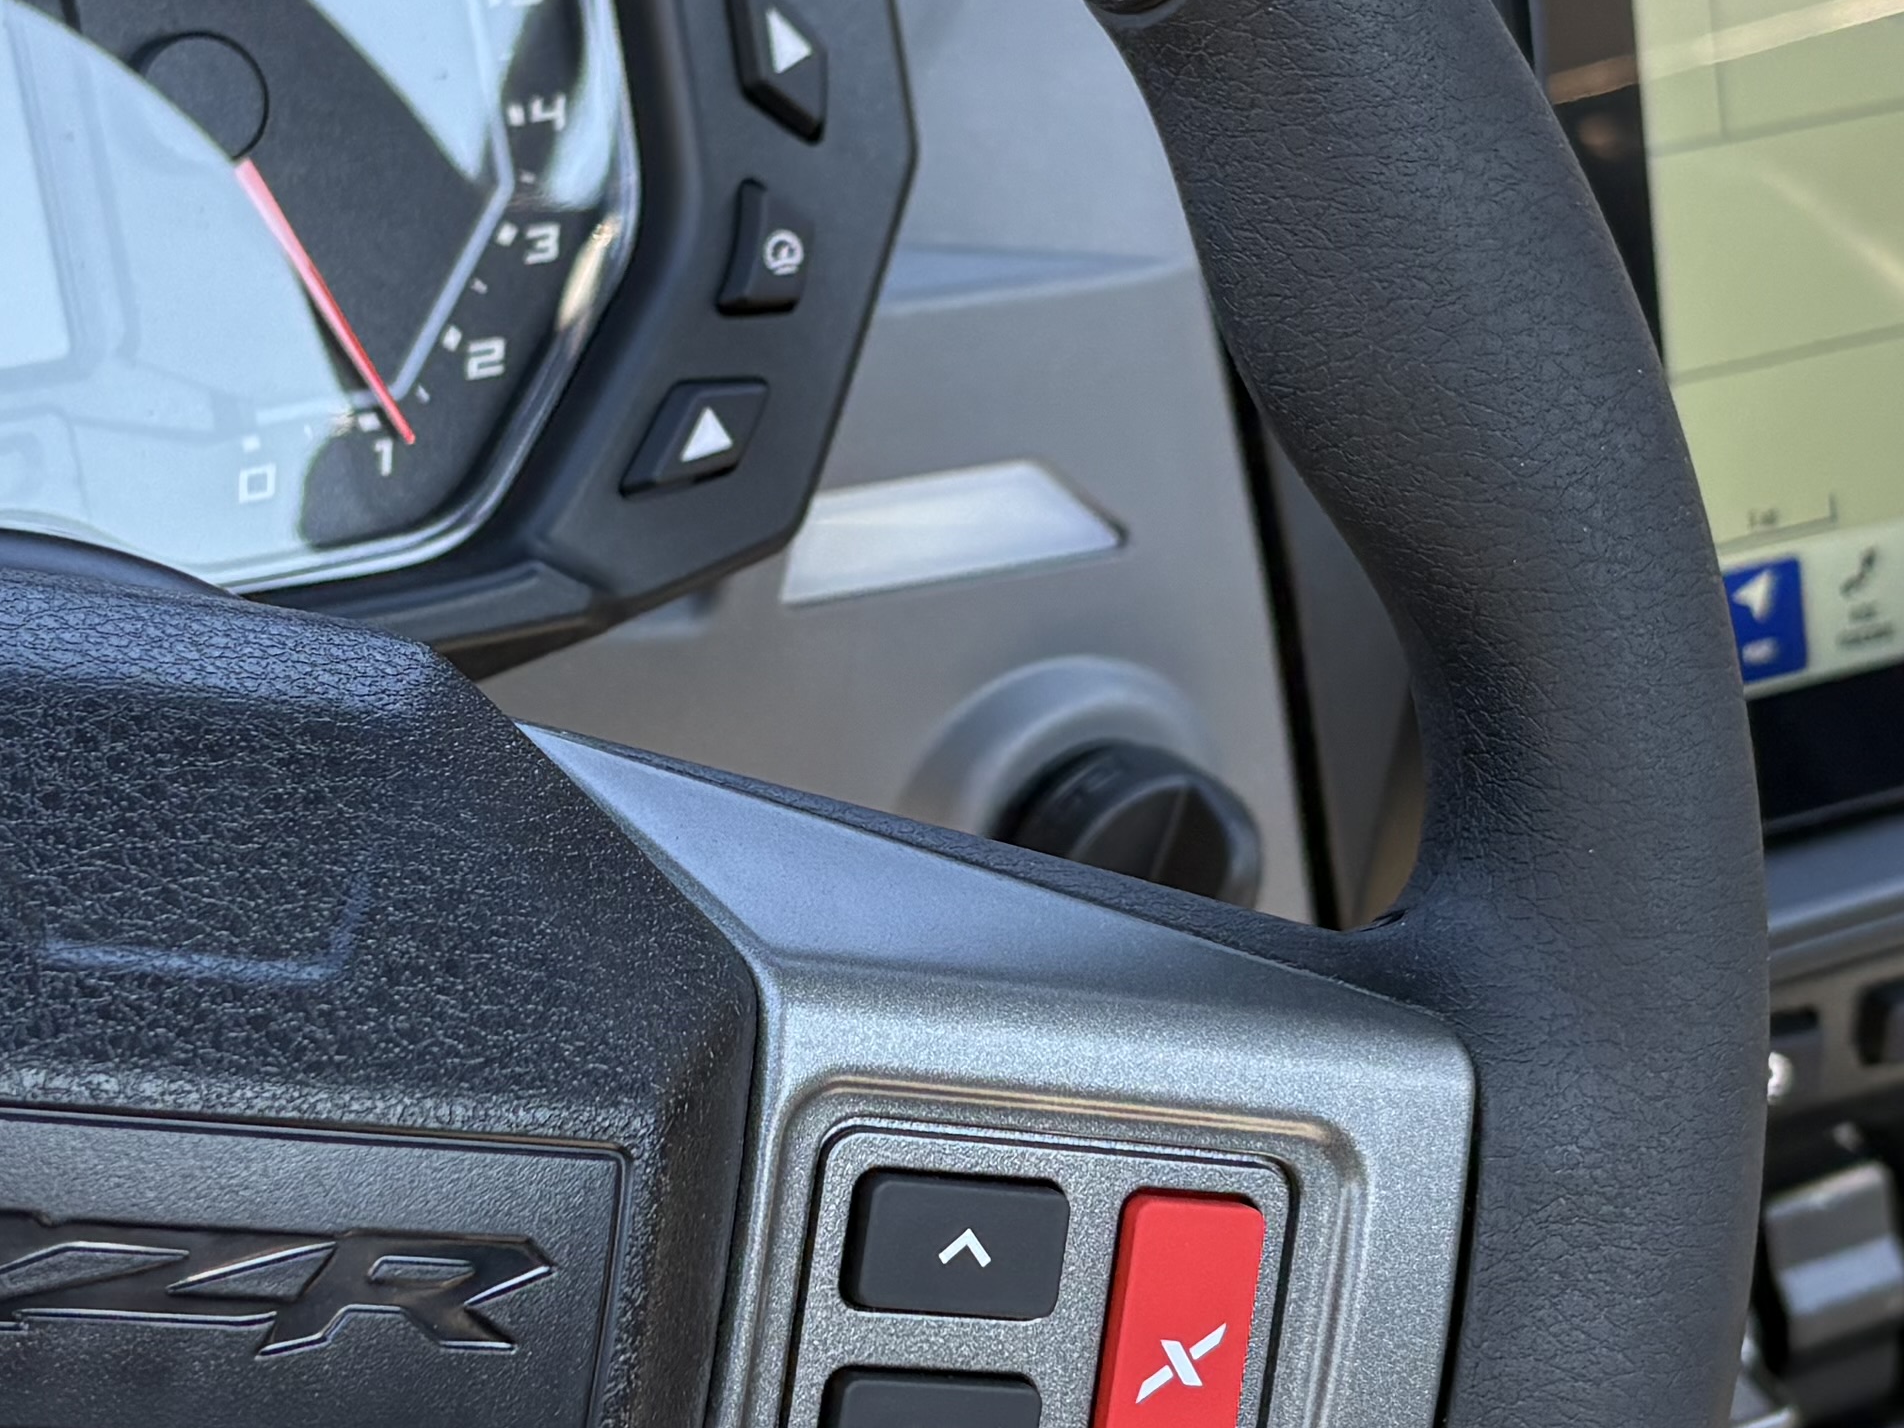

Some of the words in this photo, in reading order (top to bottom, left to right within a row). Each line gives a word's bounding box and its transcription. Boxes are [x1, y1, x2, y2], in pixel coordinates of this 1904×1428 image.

[530, 93, 566, 130] 4
[524, 223, 561, 265] 3
[466, 337, 506, 380] 2
[375, 439, 393, 477] 1
[238, 463, 276, 504] 0
